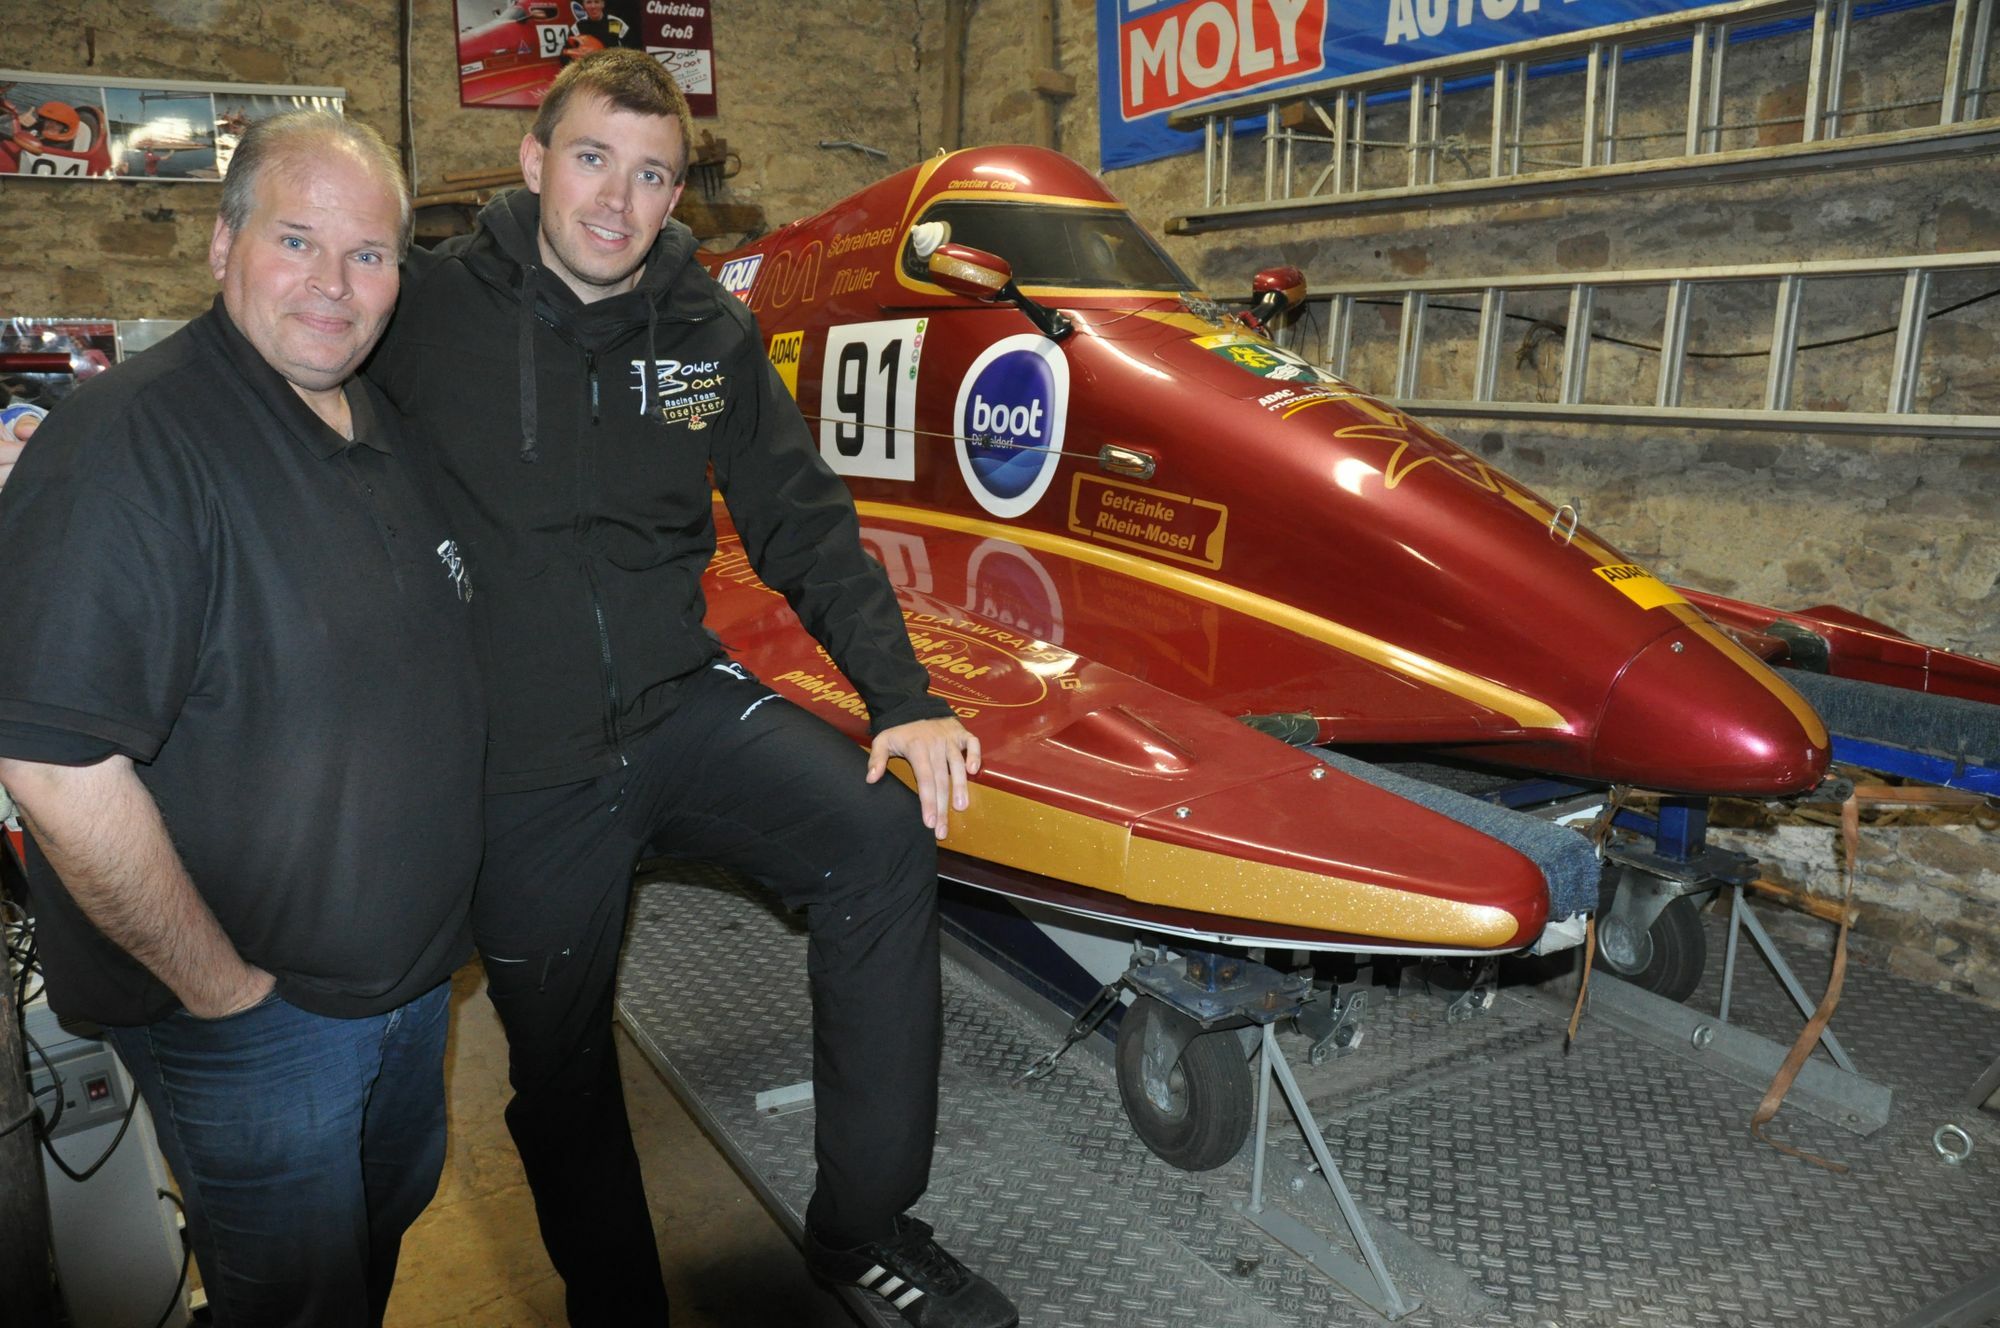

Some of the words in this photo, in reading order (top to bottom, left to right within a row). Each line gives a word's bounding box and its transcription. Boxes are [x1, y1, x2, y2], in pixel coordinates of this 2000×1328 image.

[646, 0, 705, 18] Christian
[661, 23, 694, 40] Groß
[1129, 0, 1307, 108] MOLY
[948, 179, 988, 189] Christian
[990, 180, 1017, 191] Groß
[827, 221, 899, 258] Schreinerei
[830, 267, 881, 296] Müller
[770, 336, 800, 365] ADAC
[664, 396, 692, 408] Racing
[693, 392, 717, 403] Team
[835, 338, 902, 460] 91
[1258, 388, 1295, 407] ADAC
[973, 394, 1043, 438] boot
[971, 432, 1015, 449] Düeldorf
[1101, 489, 1175, 522] Getränke
[1096, 510, 1196, 552] Rhein-Mosel
[919, 653, 992, 680] plot
